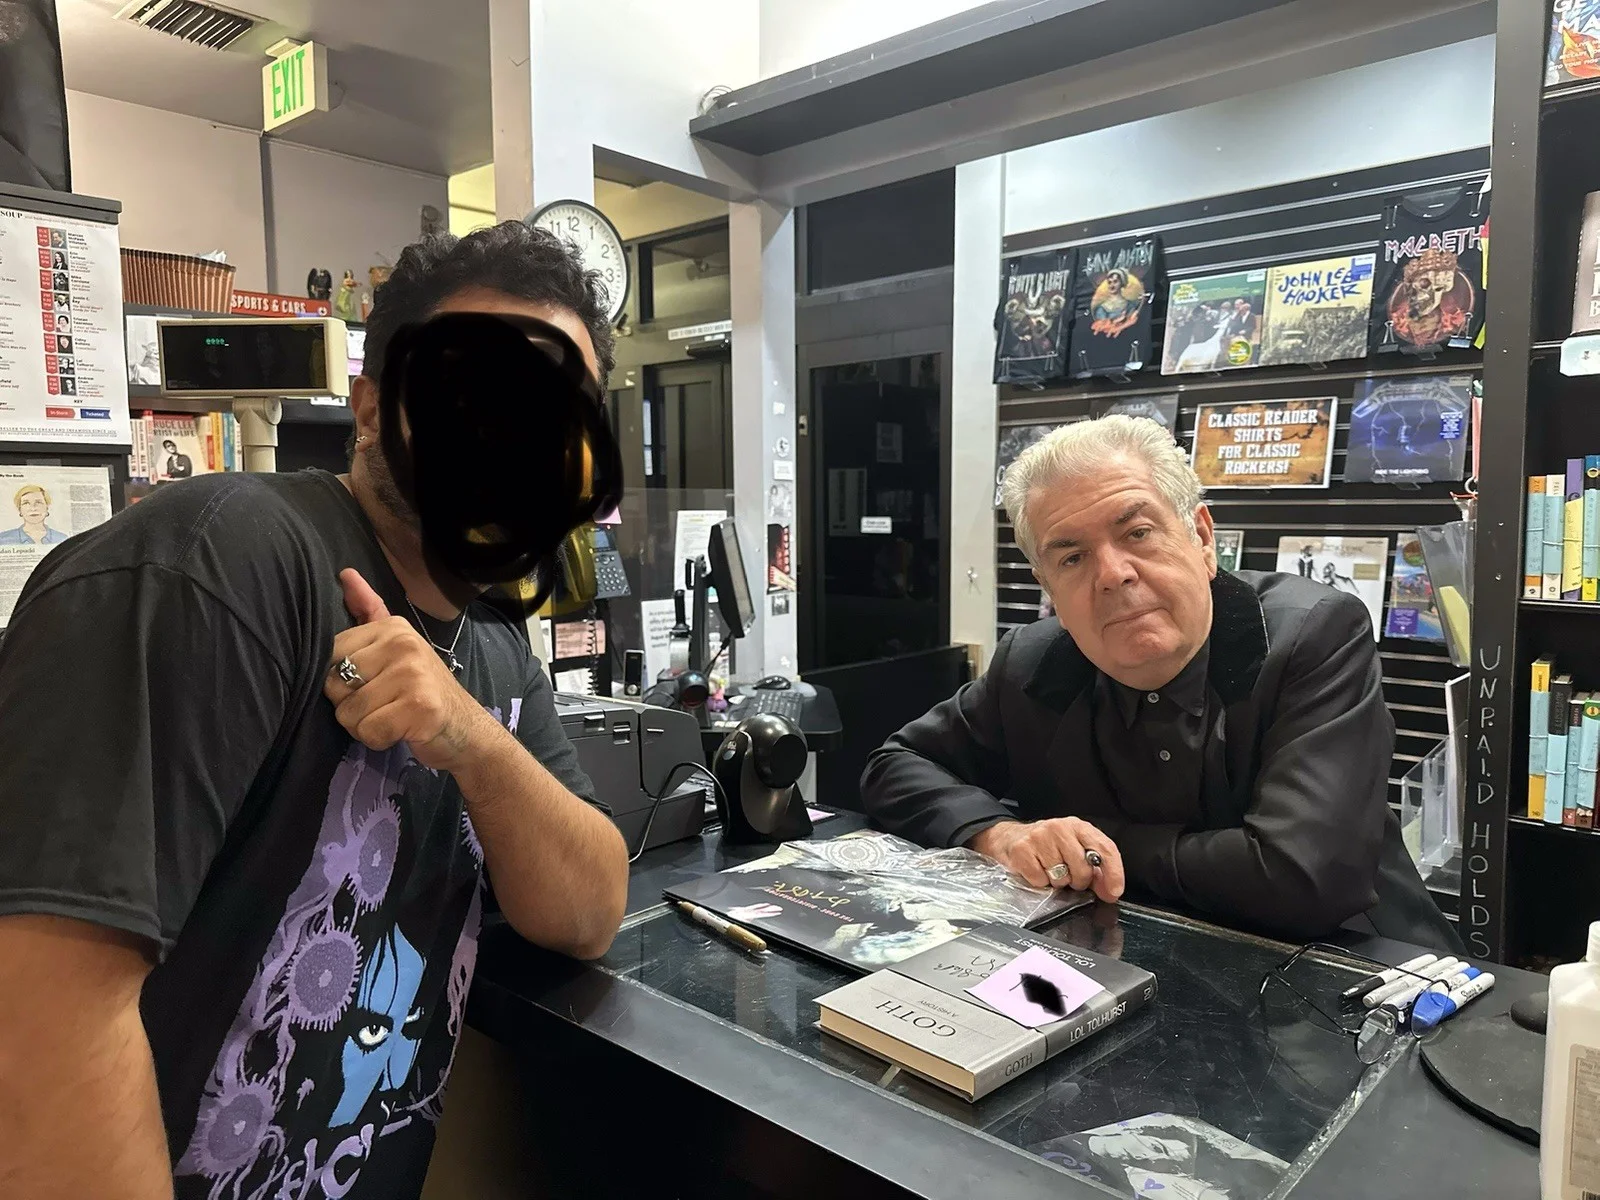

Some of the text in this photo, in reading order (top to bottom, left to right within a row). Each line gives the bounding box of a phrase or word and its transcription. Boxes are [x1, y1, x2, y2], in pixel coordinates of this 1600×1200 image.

[272, 49, 305, 119] EXIT
[0, 210, 23, 219] SOUP
[550, 220, 561, 235] 11
[567, 216, 580, 232] 12
[589, 225, 594, 240] 1
[601, 244, 610, 259] 2
[1384, 225, 1485, 264] MACBETH
[605, 268, 615, 283] 3
[1278, 270, 1322, 292] JOHN
[1326, 267, 1352, 287] LEE
[1283, 284, 1361, 305] HOOKER
[231, 294, 307, 314] SPORTS & CARS
[153, 420, 176, 430] RUCE
[1208, 409, 1318, 428] CLASSIC READER
[1233, 428, 1282, 443] SHIRTS
[1217, 443, 1301, 460] FOR CLASSIC
[1224, 460, 1290, 475] ROCKERS!
[1467, 821, 1490, 958] HOLDS
[1074, 957, 1096, 969] LOL
[876, 1001, 956, 1037] GOTH
[1070, 1001, 1127, 1042] LOL TOLHURST
[1005, 1053, 1033, 1077] GOTH
